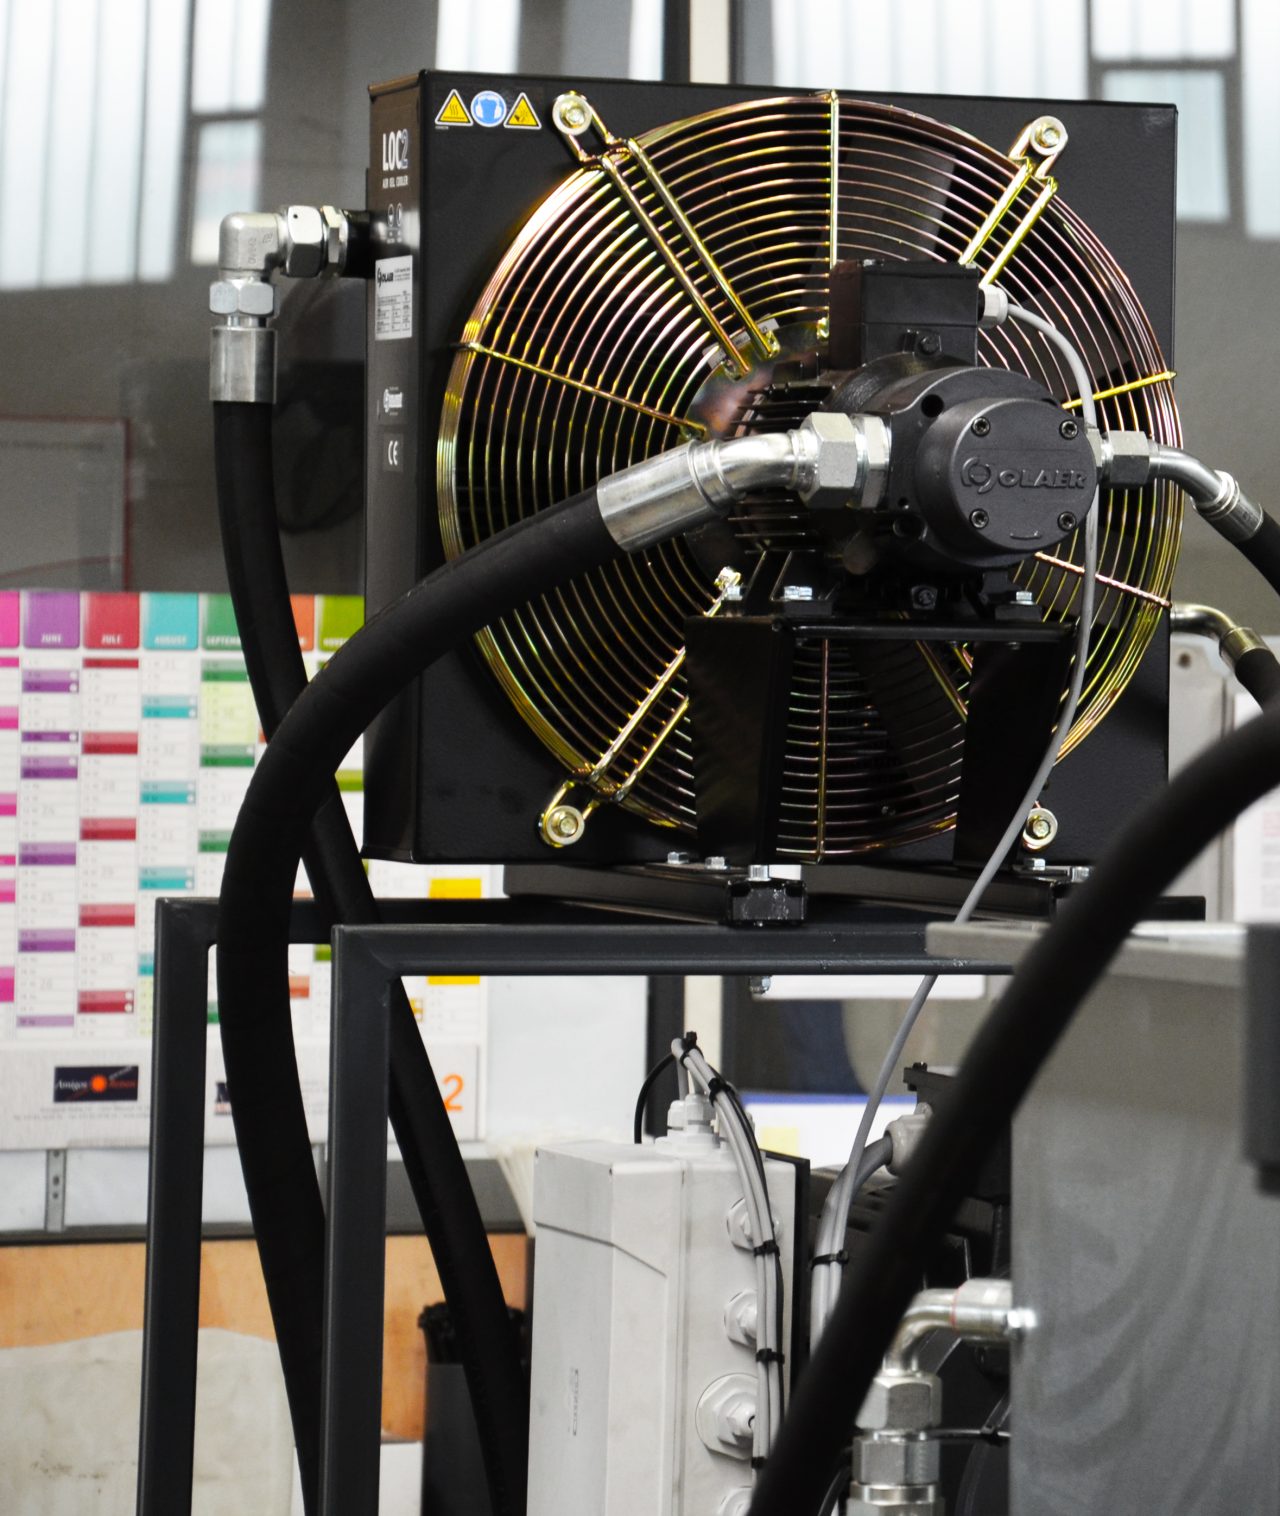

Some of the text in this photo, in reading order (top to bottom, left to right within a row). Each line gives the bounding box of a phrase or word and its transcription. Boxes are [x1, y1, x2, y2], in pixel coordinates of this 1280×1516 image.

[382, 128, 409, 171] LOC2
[998, 468, 1088, 489] OLAER
[443, 1073, 464, 1112] 2
